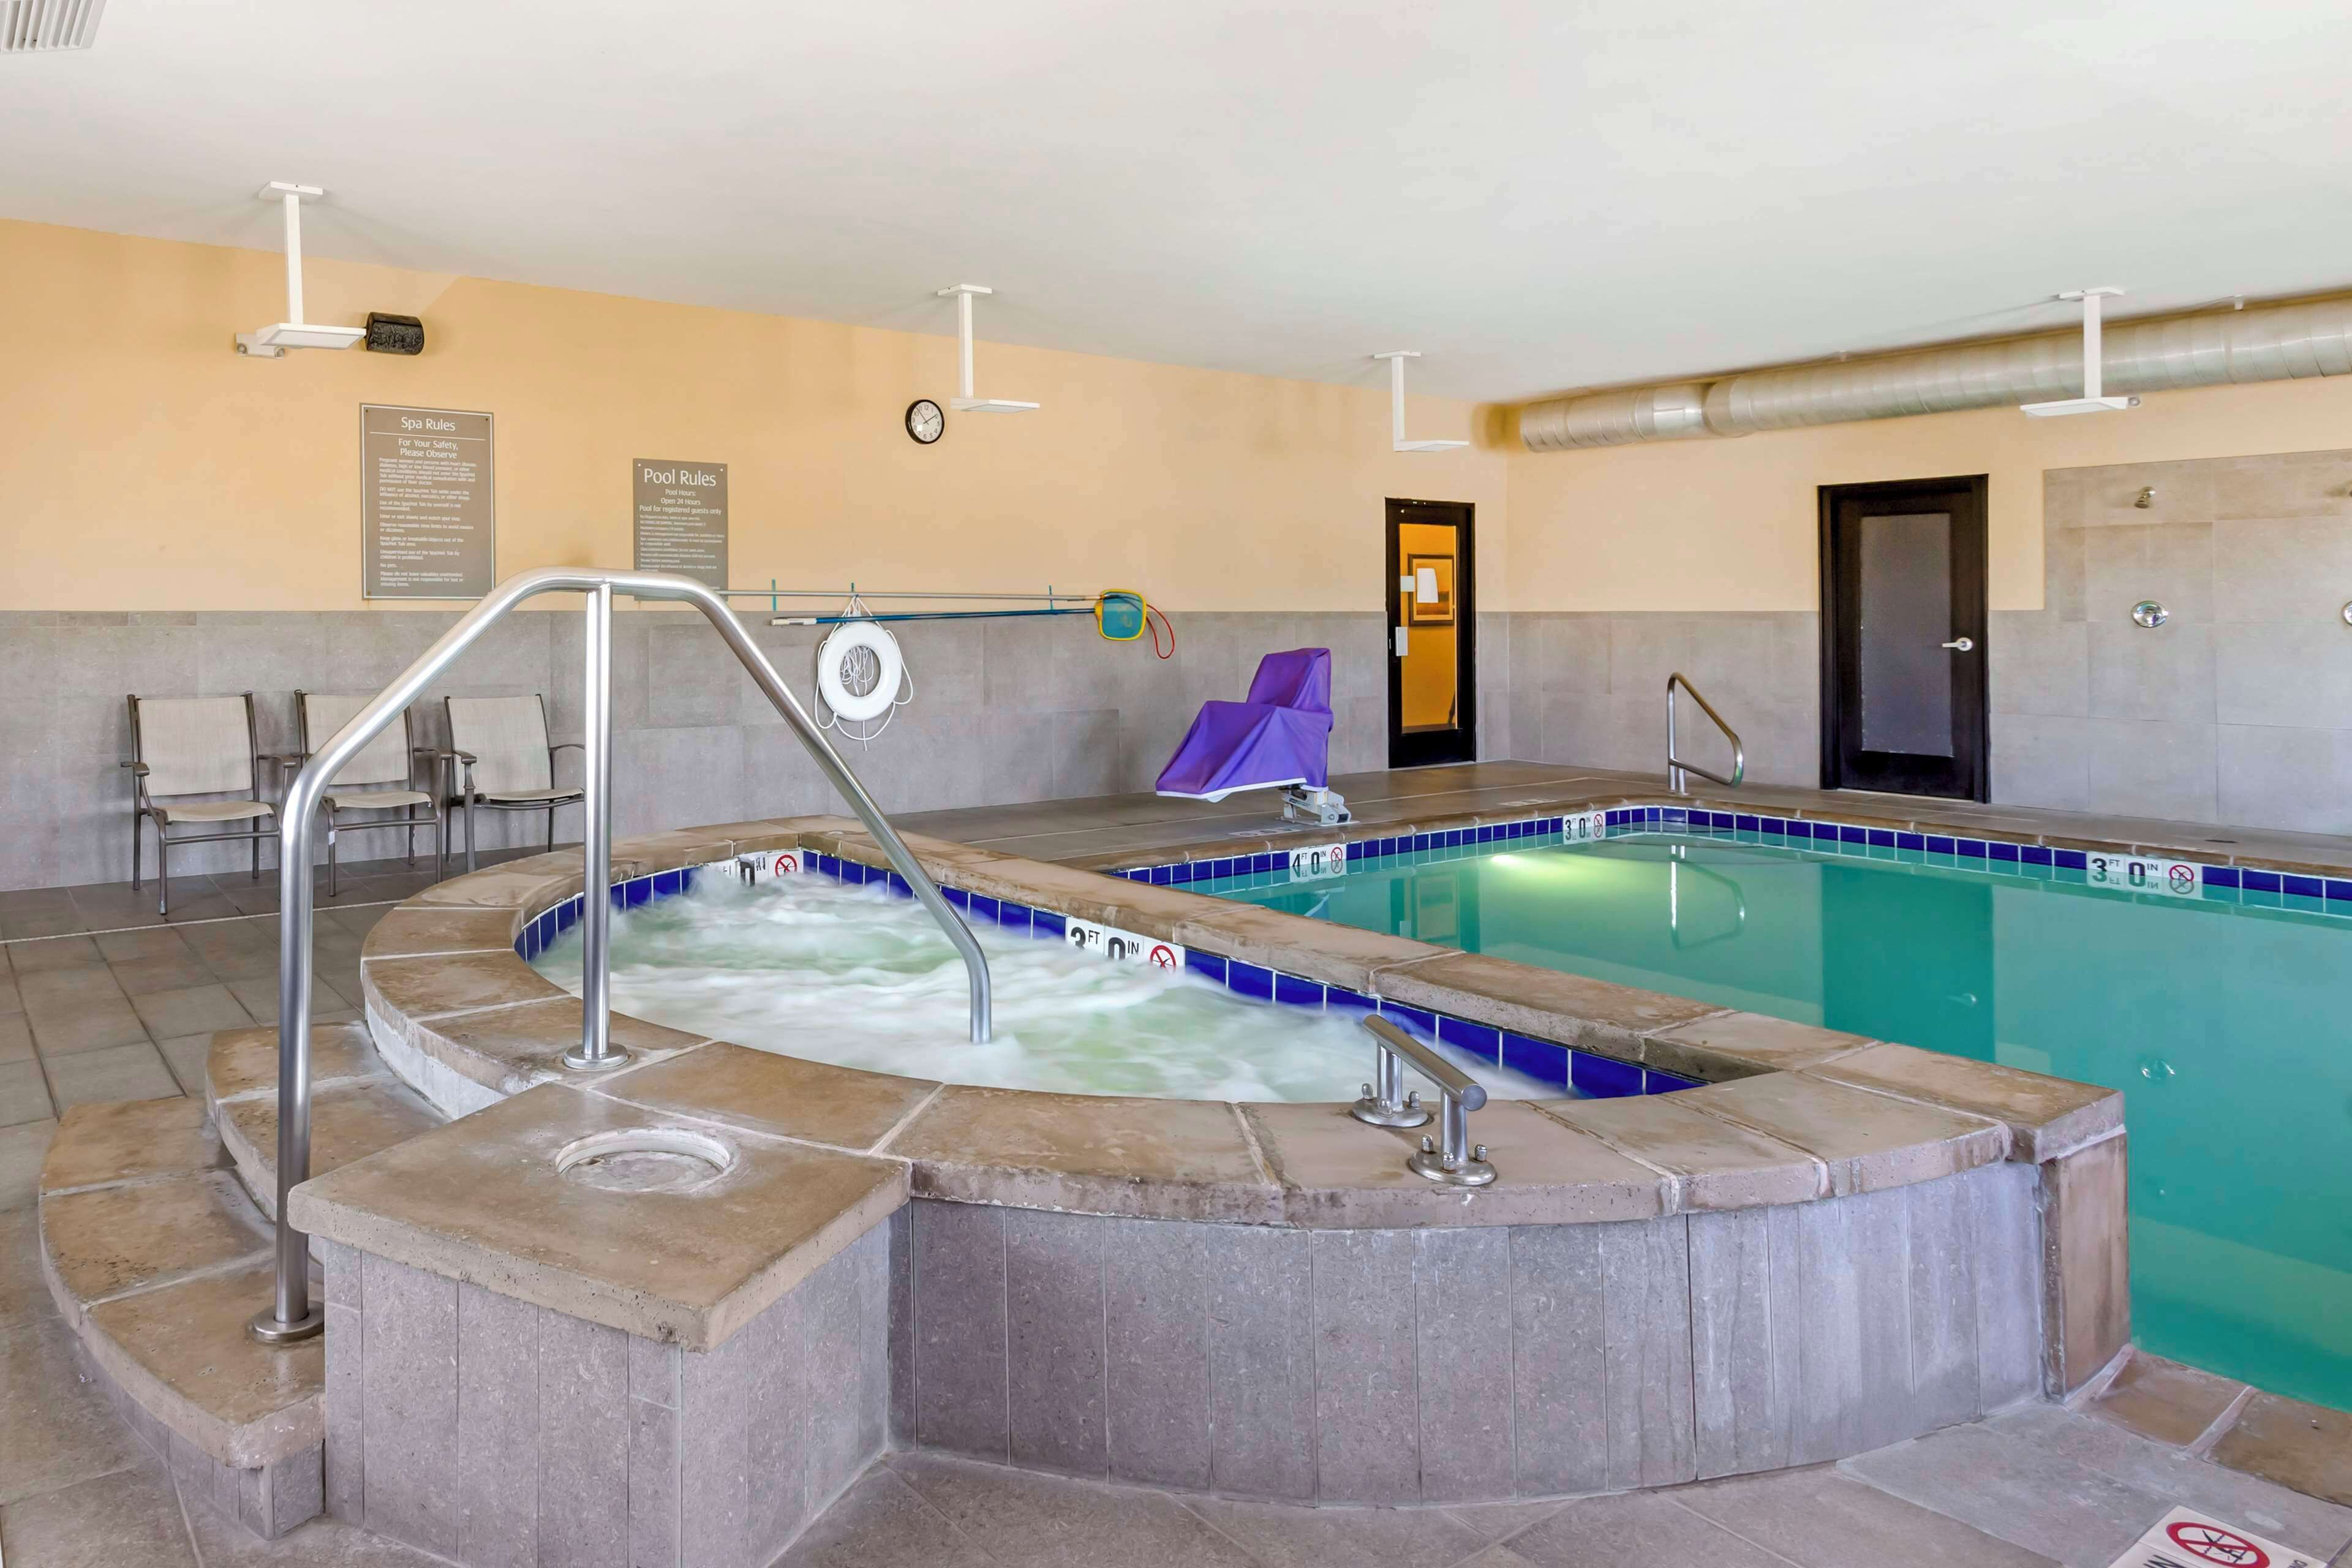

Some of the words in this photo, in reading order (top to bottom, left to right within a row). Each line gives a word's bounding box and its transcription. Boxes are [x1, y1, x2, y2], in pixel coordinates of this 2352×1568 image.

[401, 417, 423, 431] Spa
[426, 418, 456, 431] Rules
[398, 438, 411, 447] For
[413, 439, 431, 448] Your
[433, 440, 458, 451] Safety,
[400, 448, 424, 456] Please
[426, 450, 458, 459] Observe
[644, 468, 675, 484] Pool
[680, 470, 716, 486] Rules
[1311, 851, 1320, 864] 0
[2092, 858, 2107, 872] 3
[2128, 862, 2145, 876] 0
[1070, 926, 1086, 949] 3
[1088, 930, 1101, 944] FT
[1108, 937, 1126, 961] 0
[1128, 940, 1139, 956] IN
